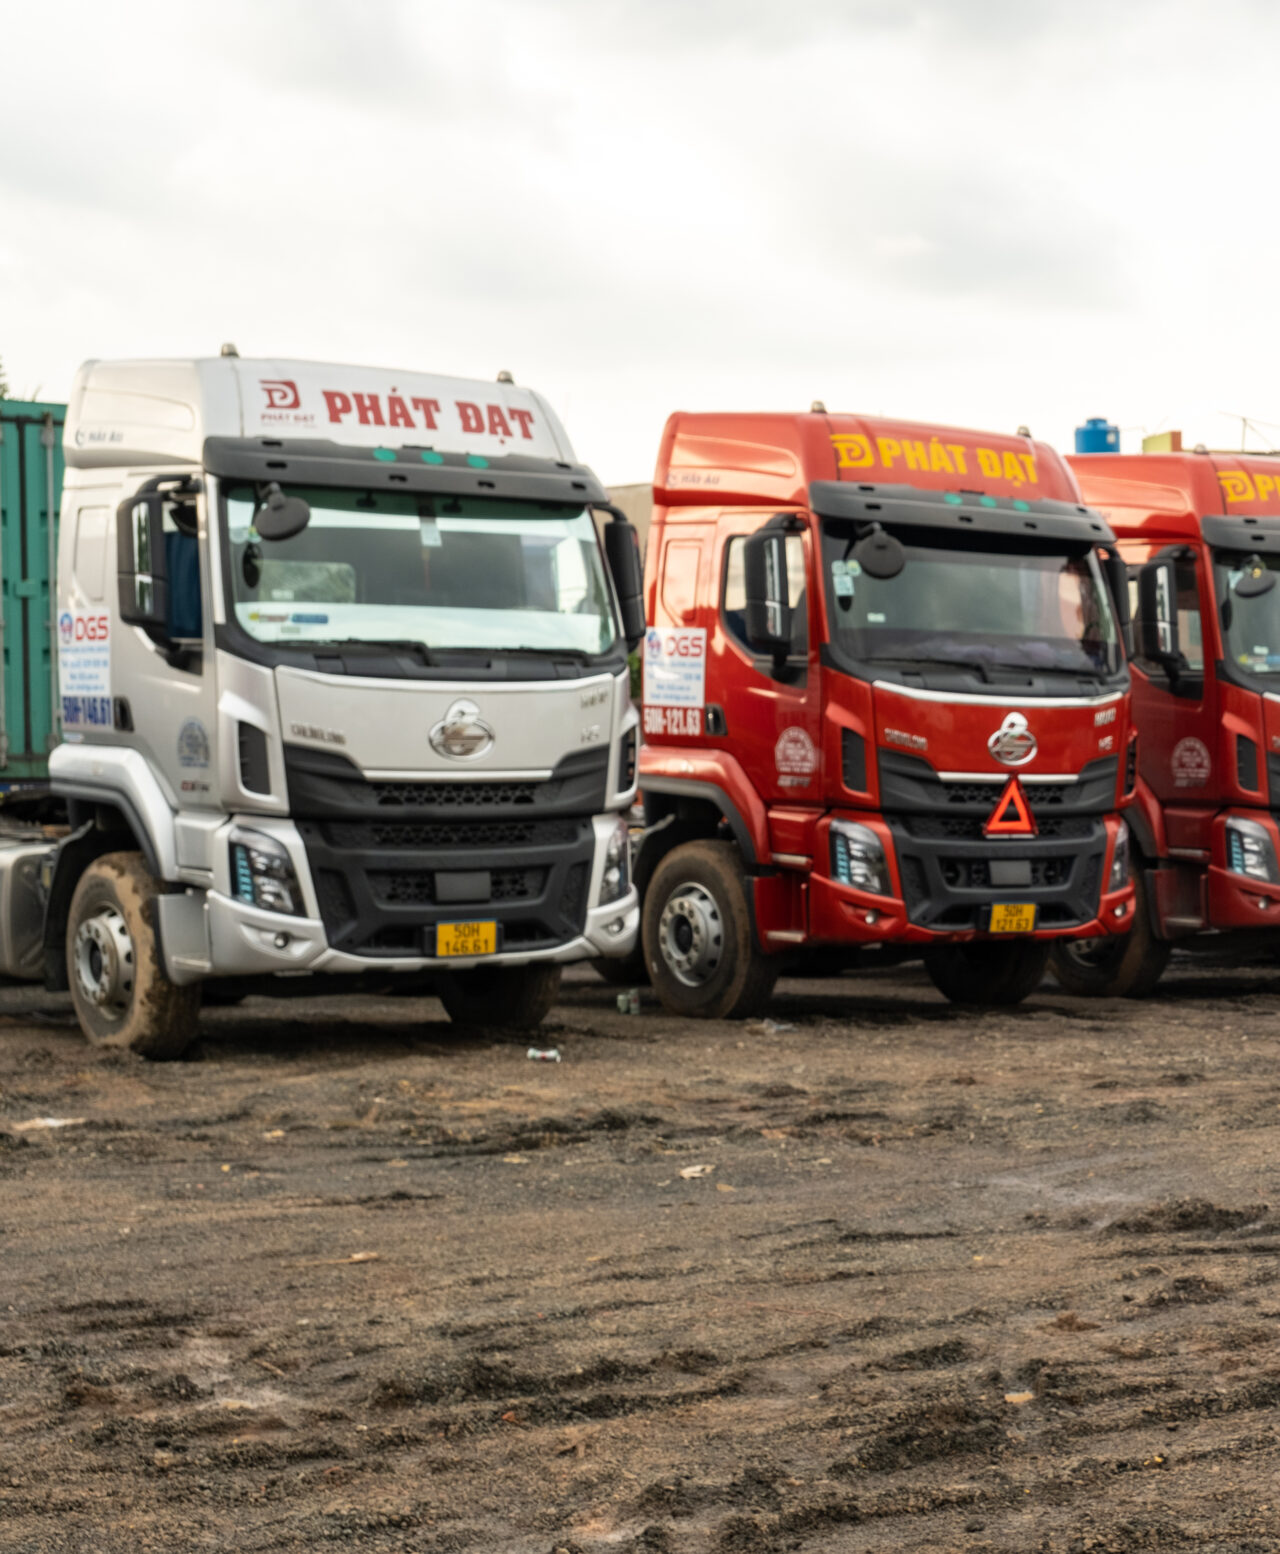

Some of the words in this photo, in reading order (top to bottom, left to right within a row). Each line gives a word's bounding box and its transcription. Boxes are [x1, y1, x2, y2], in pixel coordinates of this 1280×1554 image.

[322, 386, 440, 430] PHÁT
[455, 401, 535, 445] ĐẠT
[876, 437, 968, 475] PHÁT
[976, 448, 1038, 487] ĐẠT
[75, 616, 108, 641] DGS
[1003, 903, 1024, 918] 50H
[453, 922, 480, 938] 50H
[996, 917, 1030, 931] 121.63
[445, 938, 490, 954] 146.61
